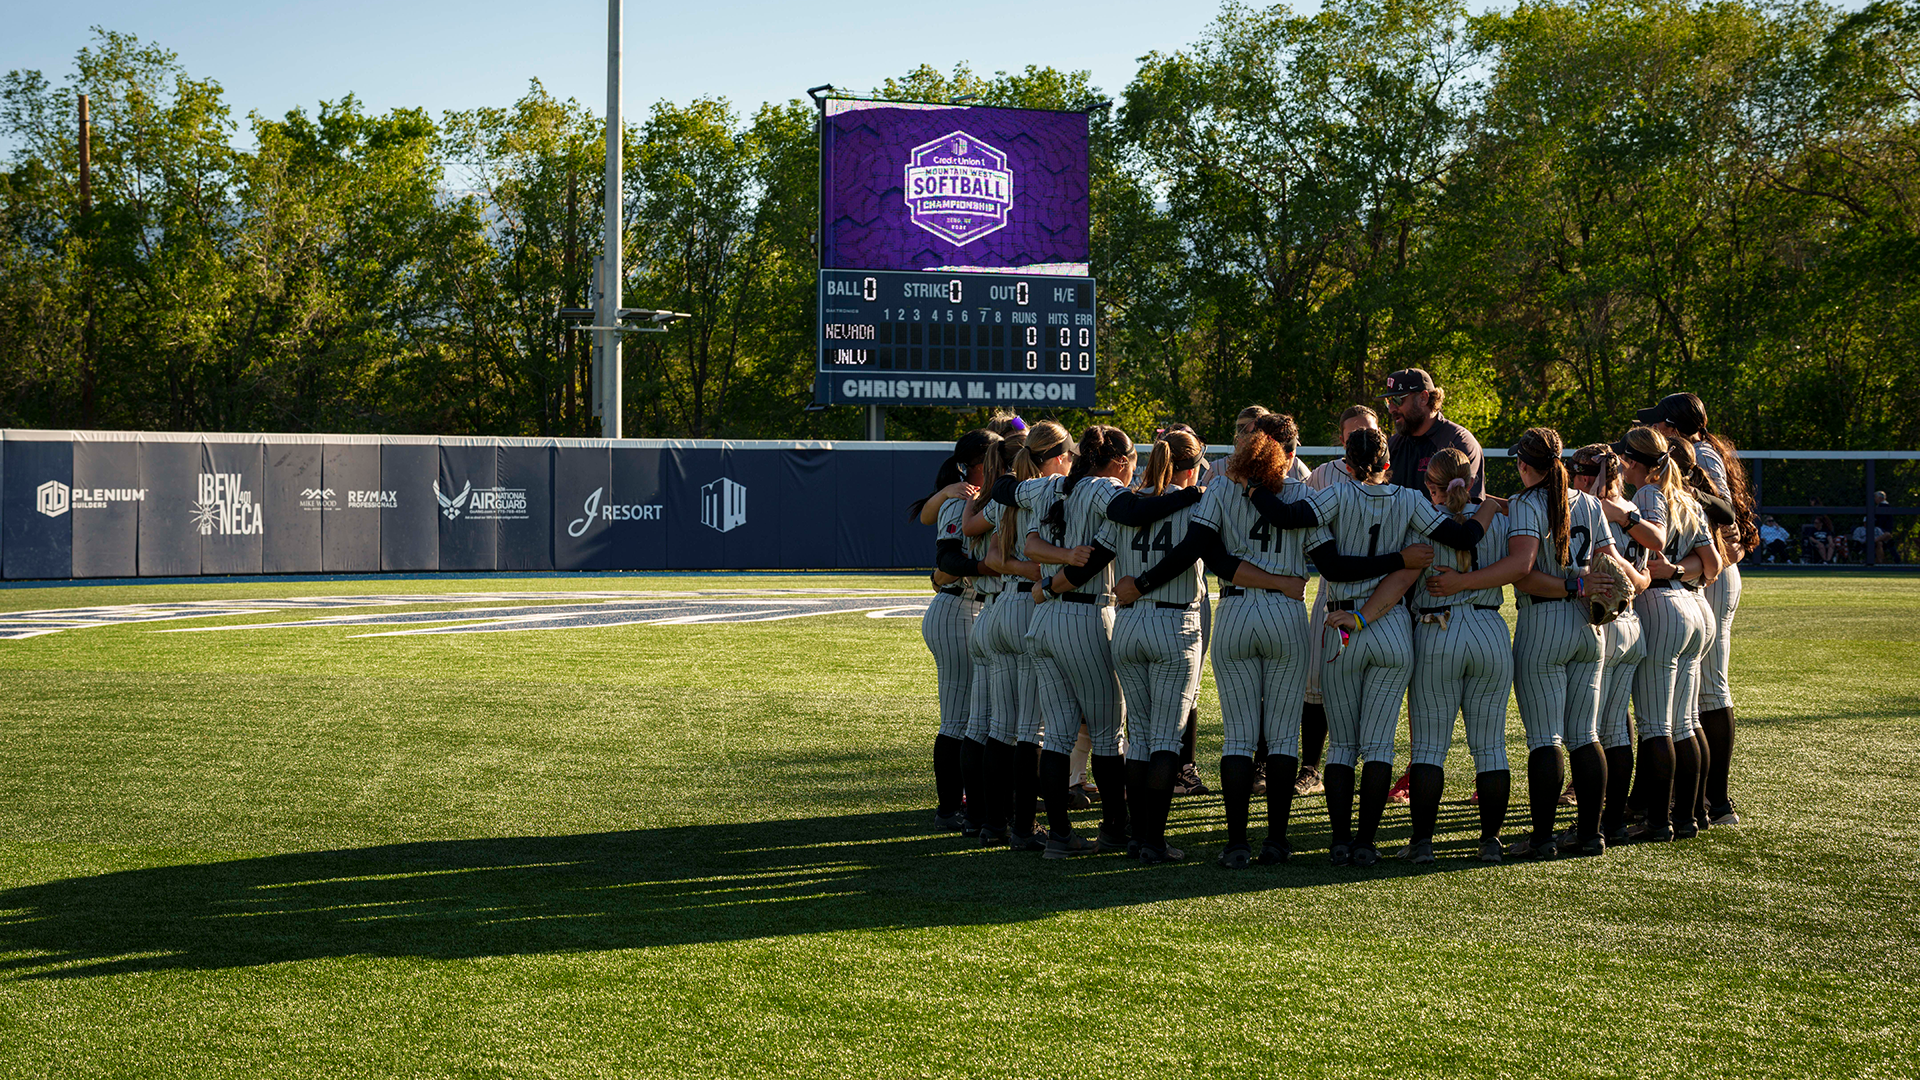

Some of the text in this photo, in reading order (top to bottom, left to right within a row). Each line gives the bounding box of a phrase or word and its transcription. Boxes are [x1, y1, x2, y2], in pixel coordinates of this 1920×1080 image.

[970, 169, 993, 178] WEST
[914, 175, 1004, 199] SOFTBALL
[923, 200, 995, 212] CHAMPIONSHIP
[827, 277, 1075, 305] BALL 0 STRIKE 0 OUT 0 H/E
[883, 308, 1093, 326] 1 2 3 4 5 6 7 8 RUNS HITS ERR
[825, 323, 1089, 347] NEVADA 0 0 0
[1026, 351, 1037, 370] 0
[1060, 352, 1070, 371] 0
[1079, 352, 1089, 371] 0
[842, 379, 1076, 400] CHRISTINA M. HIXSON
[72, 488, 145, 501] PLENIUM
[198, 473, 252, 505] IBEW 401
[348, 490, 397, 502] RE/MAX
[469, 492, 495, 509] AIR
[495, 499, 527, 509] GUARD
[220, 503, 263, 535] NECA
[602, 504, 663, 520] RESORT
[1131, 521, 1174, 563] 44
